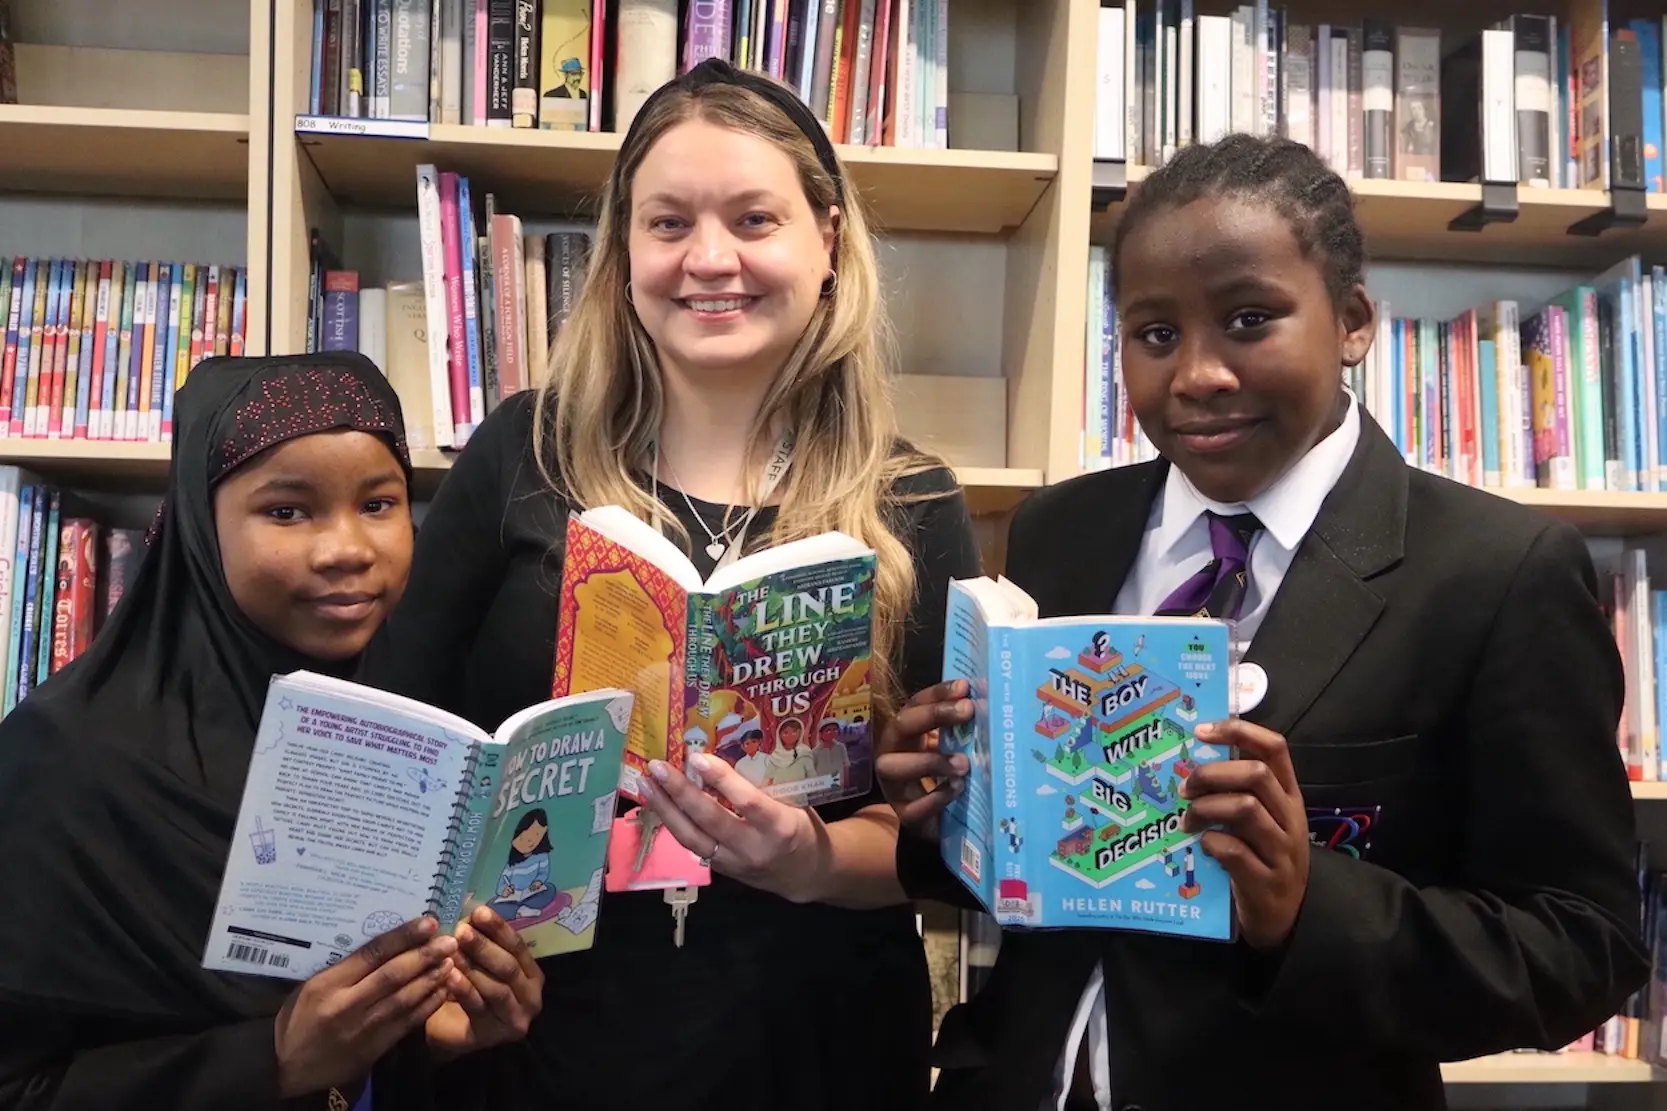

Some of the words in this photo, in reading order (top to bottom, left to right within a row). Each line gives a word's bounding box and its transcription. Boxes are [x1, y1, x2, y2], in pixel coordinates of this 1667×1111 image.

[376, 26, 388, 57] WRITE
[376, 58, 388, 96] ESSAYS
[492, 53, 500, 110] VANDERMEER
[500, 86, 508, 110] JEFF
[296, 119, 316, 130] 808
[328, 120, 367, 134] Writing
[502, 254, 510, 285] CORNER
[562, 267, 570, 278] OF
[450, 275, 460, 312] Women
[504, 288, 510, 298] OF
[334, 290, 346, 341] SCOTTISH
[453, 314, 462, 339] Who
[414, 328, 427, 343] Q
[454, 340, 464, 367] Write
[506, 342, 514, 364] FIELD
[768, 442, 793, 480] STAFF
[30, 512, 42, 550] SPORTING
[736, 585, 769, 607] THE
[755, 582, 856, 634] LINE
[24, 602, 34, 632] CRICKET
[55, 598, 74, 658] Torres
[702, 605, 712, 625] THE
[686, 624, 698, 674] THROUGH
[700, 624, 713, 653] LINE
[763, 621, 828, 652] THEY
[1188, 644, 1204, 652] YOU
[731, 645, 824, 688] DREW
[1001, 650, 1012, 681] BOY
[1178, 662, 1194, 670] THE
[1194, 662, 1216, 670] NEXT
[1180, 653, 1212, 662] CHOOSE
[686, 674, 698, 688] US
[747, 666, 841, 699] THROUGH
[1004, 683, 1012, 702] WITH
[1048, 669, 1092, 706] THE
[697, 680, 712, 720] DREW
[771, 692, 812, 717] US
[1102, 676, 1149, 718] BOY
[296, 704, 308, 713] THE
[310, 708, 357, 724] EMPOWERING
[358, 719, 425, 742] AUTOBIOGRAPHICAL
[426, 738, 448, 749] STORY
[1002, 704, 1014, 727] BIG
[296, 725, 310, 733] HER
[312, 728, 332, 738] VOICE
[334, 733, 344, 741] TO
[345, 735, 363, 745] SAVE
[364, 739, 384, 750] WHAT
[385, 745, 417, 759] MATTERS
[418, 754, 438, 765] MOST
[300, 715, 310, 723] OF
[318, 720, 342, 731] YOUNG
[344, 726, 367, 736] ARTIST
[370, 732, 410, 747] STRUGGLING
[422, 746, 439, 756] FIND
[530, 742, 546, 765] TO
[550, 730, 594, 760] DRAW
[594, 728, 604, 750] A
[1103, 718, 1163, 766] WITH
[1002, 729, 1017, 809] DECISIONS
[493, 757, 596, 818] SECRET
[1092, 779, 1132, 812] BIG
[467, 812, 482, 833] HOW
[1095, 808, 1186, 870] DECISIO
[455, 849, 472, 878] DRAW
[442, 888, 462, 924] SECRET
[1062, 898, 1122, 912] HELEN
[1131, 900, 1201, 920] RUTTER
